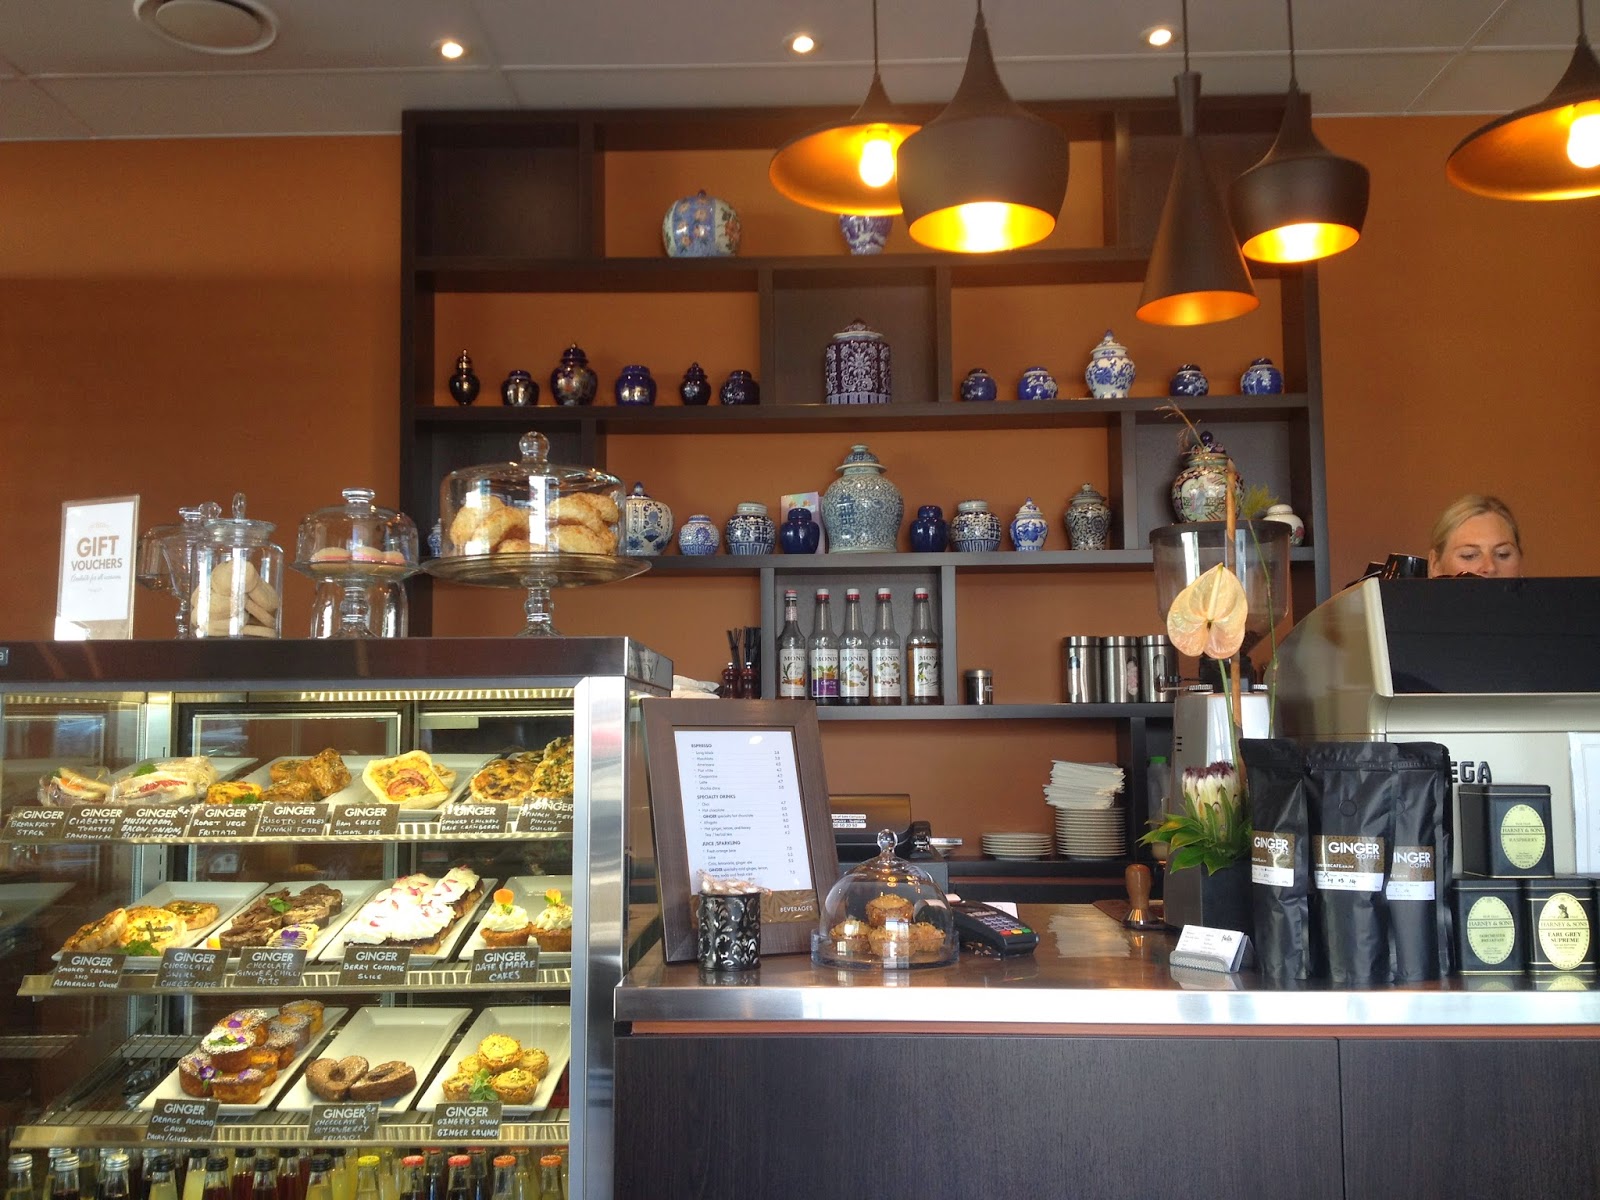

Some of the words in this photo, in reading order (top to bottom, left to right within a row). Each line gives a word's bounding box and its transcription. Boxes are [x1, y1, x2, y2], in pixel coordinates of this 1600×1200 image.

[76, 535, 120, 558] GIFT
[71, 558, 123, 571] VOUCHERS
[1450, 761, 1493, 784] EGA
[22, 810, 64, 820] GINGER
[81, 808, 122, 818] GINGER
[136, 808, 178, 818] GINGER
[204, 808, 247, 818] GINGER
[273, 806, 316, 816] GINGER
[344, 807, 387, 817] GINGER
[69, 817, 116, 825] CIABATTA
[262, 816, 296, 825] RISOTTO
[1253, 836, 1289, 850] GINGER
[1328, 842, 1380, 855] GINGER
[1393, 852, 1431, 864] INGER
[780, 905, 813, 913] BEVERAGES
[71, 955, 113, 967] GINGER
[174, 952, 216, 964] GINGER
[251, 952, 294, 962] GINGER
[355, 951, 398, 961] GINGER
[484, 951, 526, 963] GINGER
[162, 962, 213, 972] CHOCOLATE
[246, 962, 293, 970] CHOCOLATE
[343, 963, 369, 971] BERRY
[475, 962, 497, 972] DATE
[505, 960, 536, 970] MAPLE
[489, 970, 520, 981] CAKES
[53, 979, 95, 988] ASPARAGUS
[257, 977, 279, 986] POTS
[163, 1103, 206, 1116] GINGER
[323, 1108, 366, 1119] GINGER
[445, 1106, 489, 1117] GINGER
[151, 1115, 182, 1125] ORANGE
[185, 1117, 214, 1127] ALMOND
[437, 1118, 476, 1126] GINGERS
[163, 1125, 187, 1133] CAKES
[437, 1128, 469, 1137] GINGER
[471, 1128, 500, 1137] CRUNCH
